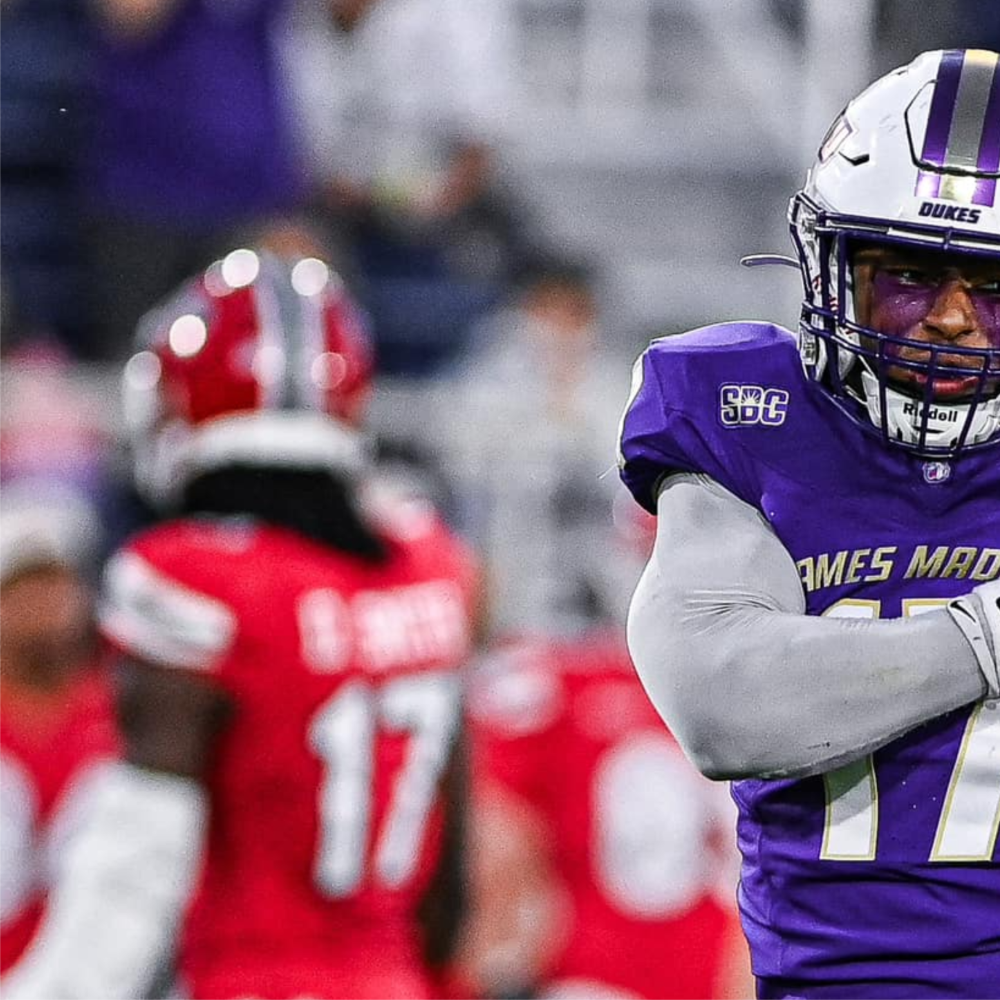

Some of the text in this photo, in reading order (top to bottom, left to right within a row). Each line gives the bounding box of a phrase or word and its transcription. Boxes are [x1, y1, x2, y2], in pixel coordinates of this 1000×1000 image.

[918, 201, 982, 224] DUKES
[720, 385, 790, 426] SBC
[796, 546, 897, 592] AMES
[308, 677, 462, 897] 17
